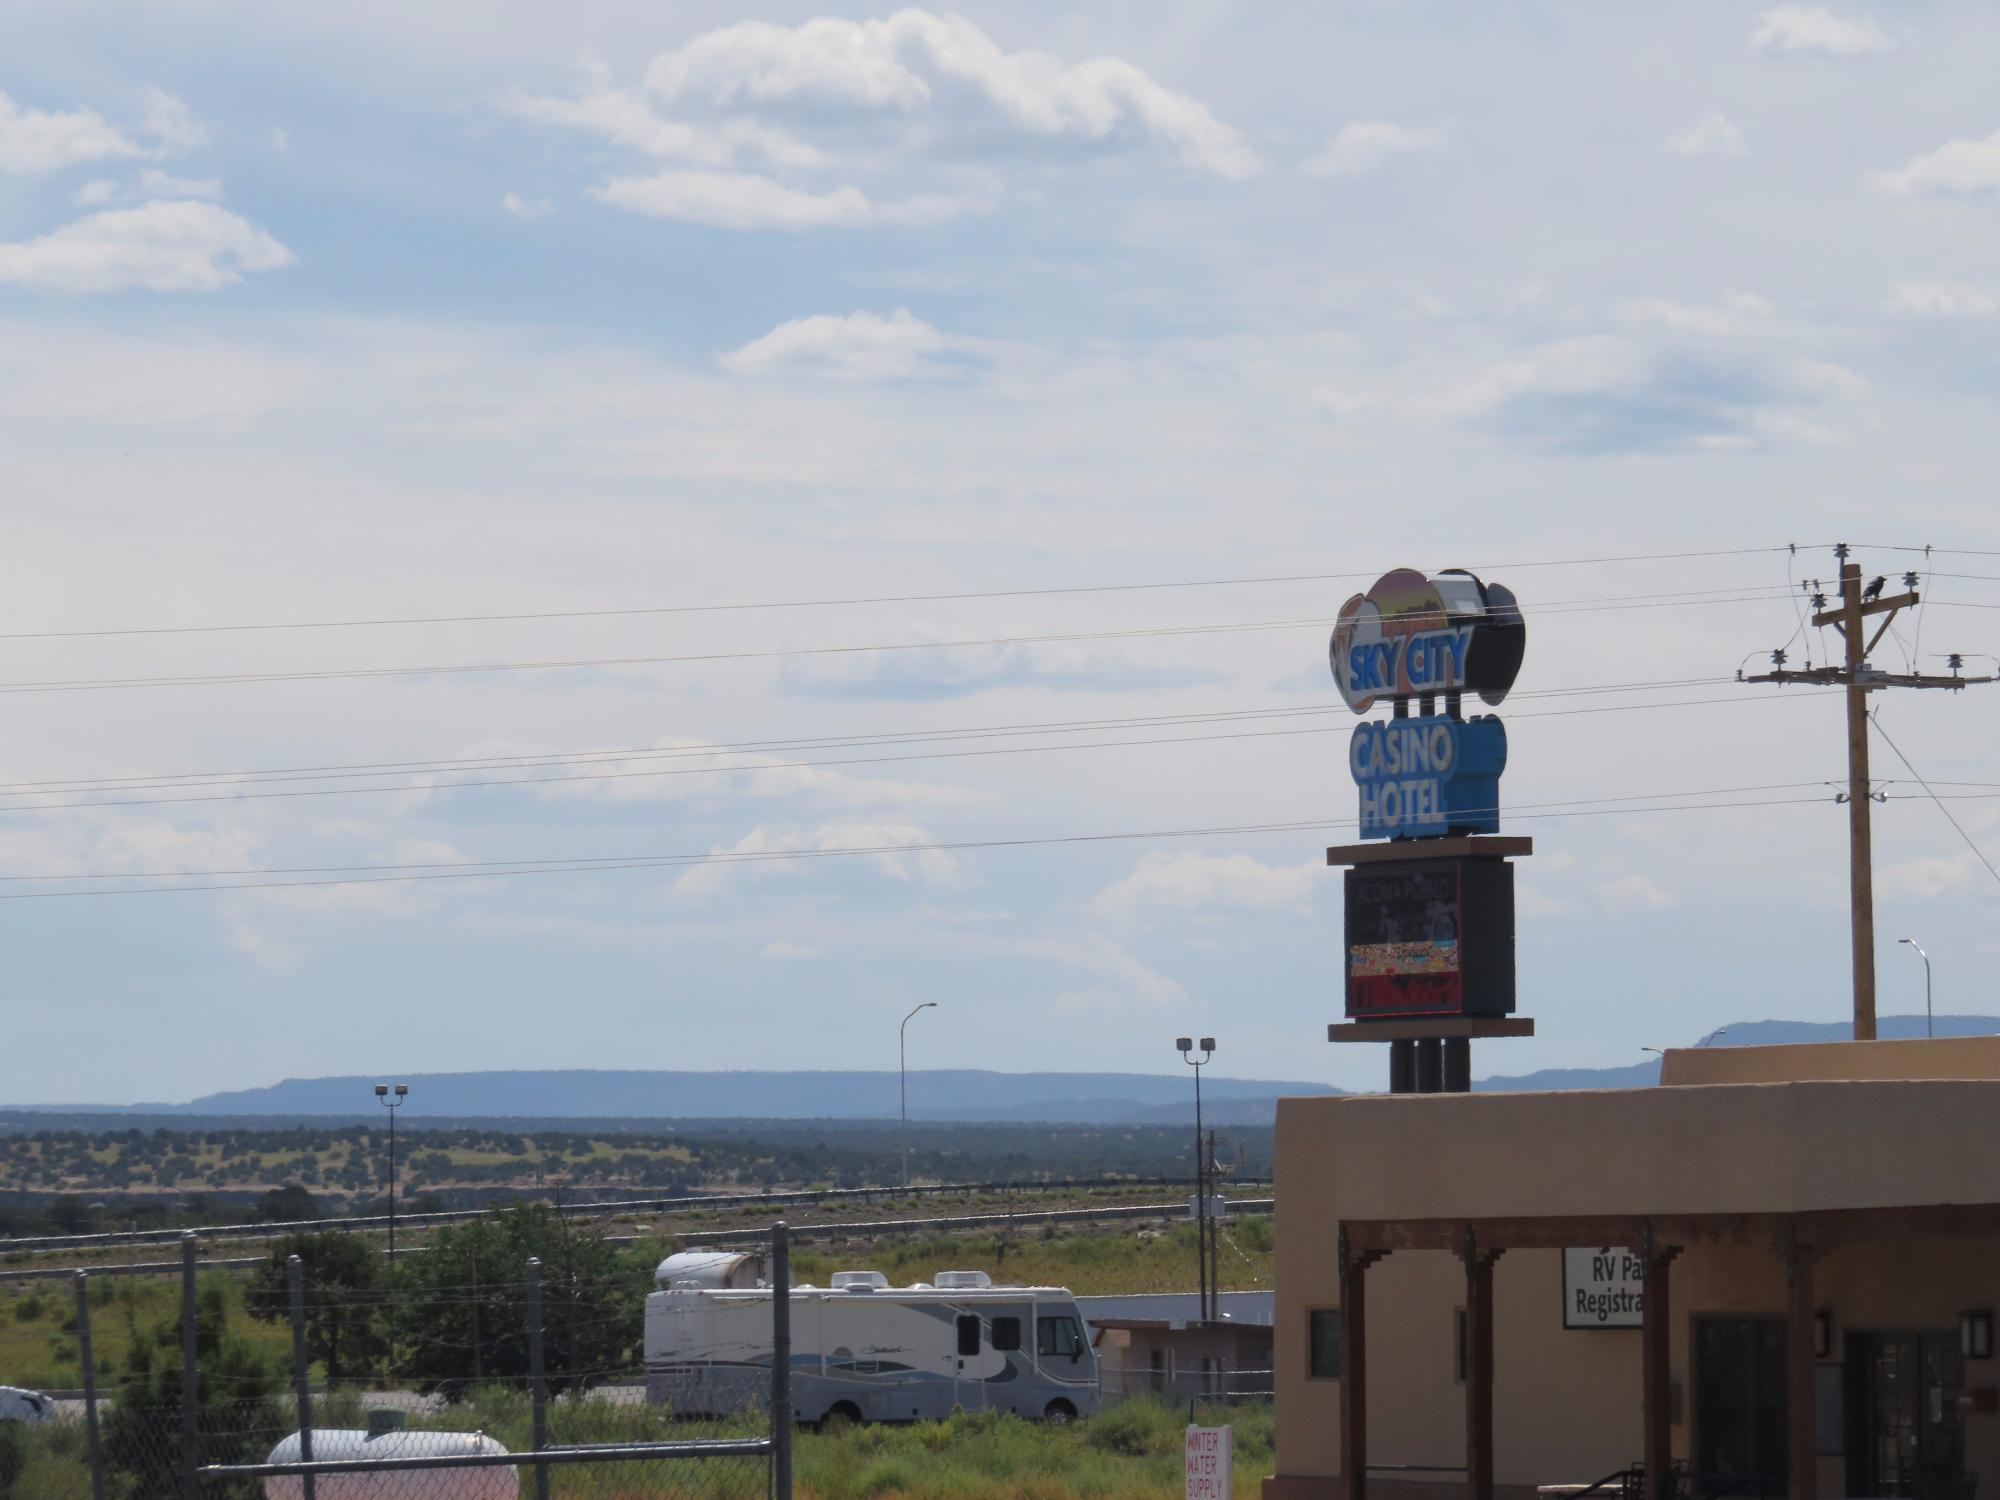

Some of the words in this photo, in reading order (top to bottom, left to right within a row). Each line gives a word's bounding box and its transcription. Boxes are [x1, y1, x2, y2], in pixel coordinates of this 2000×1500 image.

[1350, 636, 1404, 691] SKY
[1406, 628, 1472, 687] CITY
[1352, 724, 1451, 775] CASINO
[1359, 778, 1446, 829] HOTEL
[1592, 1256, 1616, 1282] RV
[1187, 1479, 1223, 1498] SUPPLY
